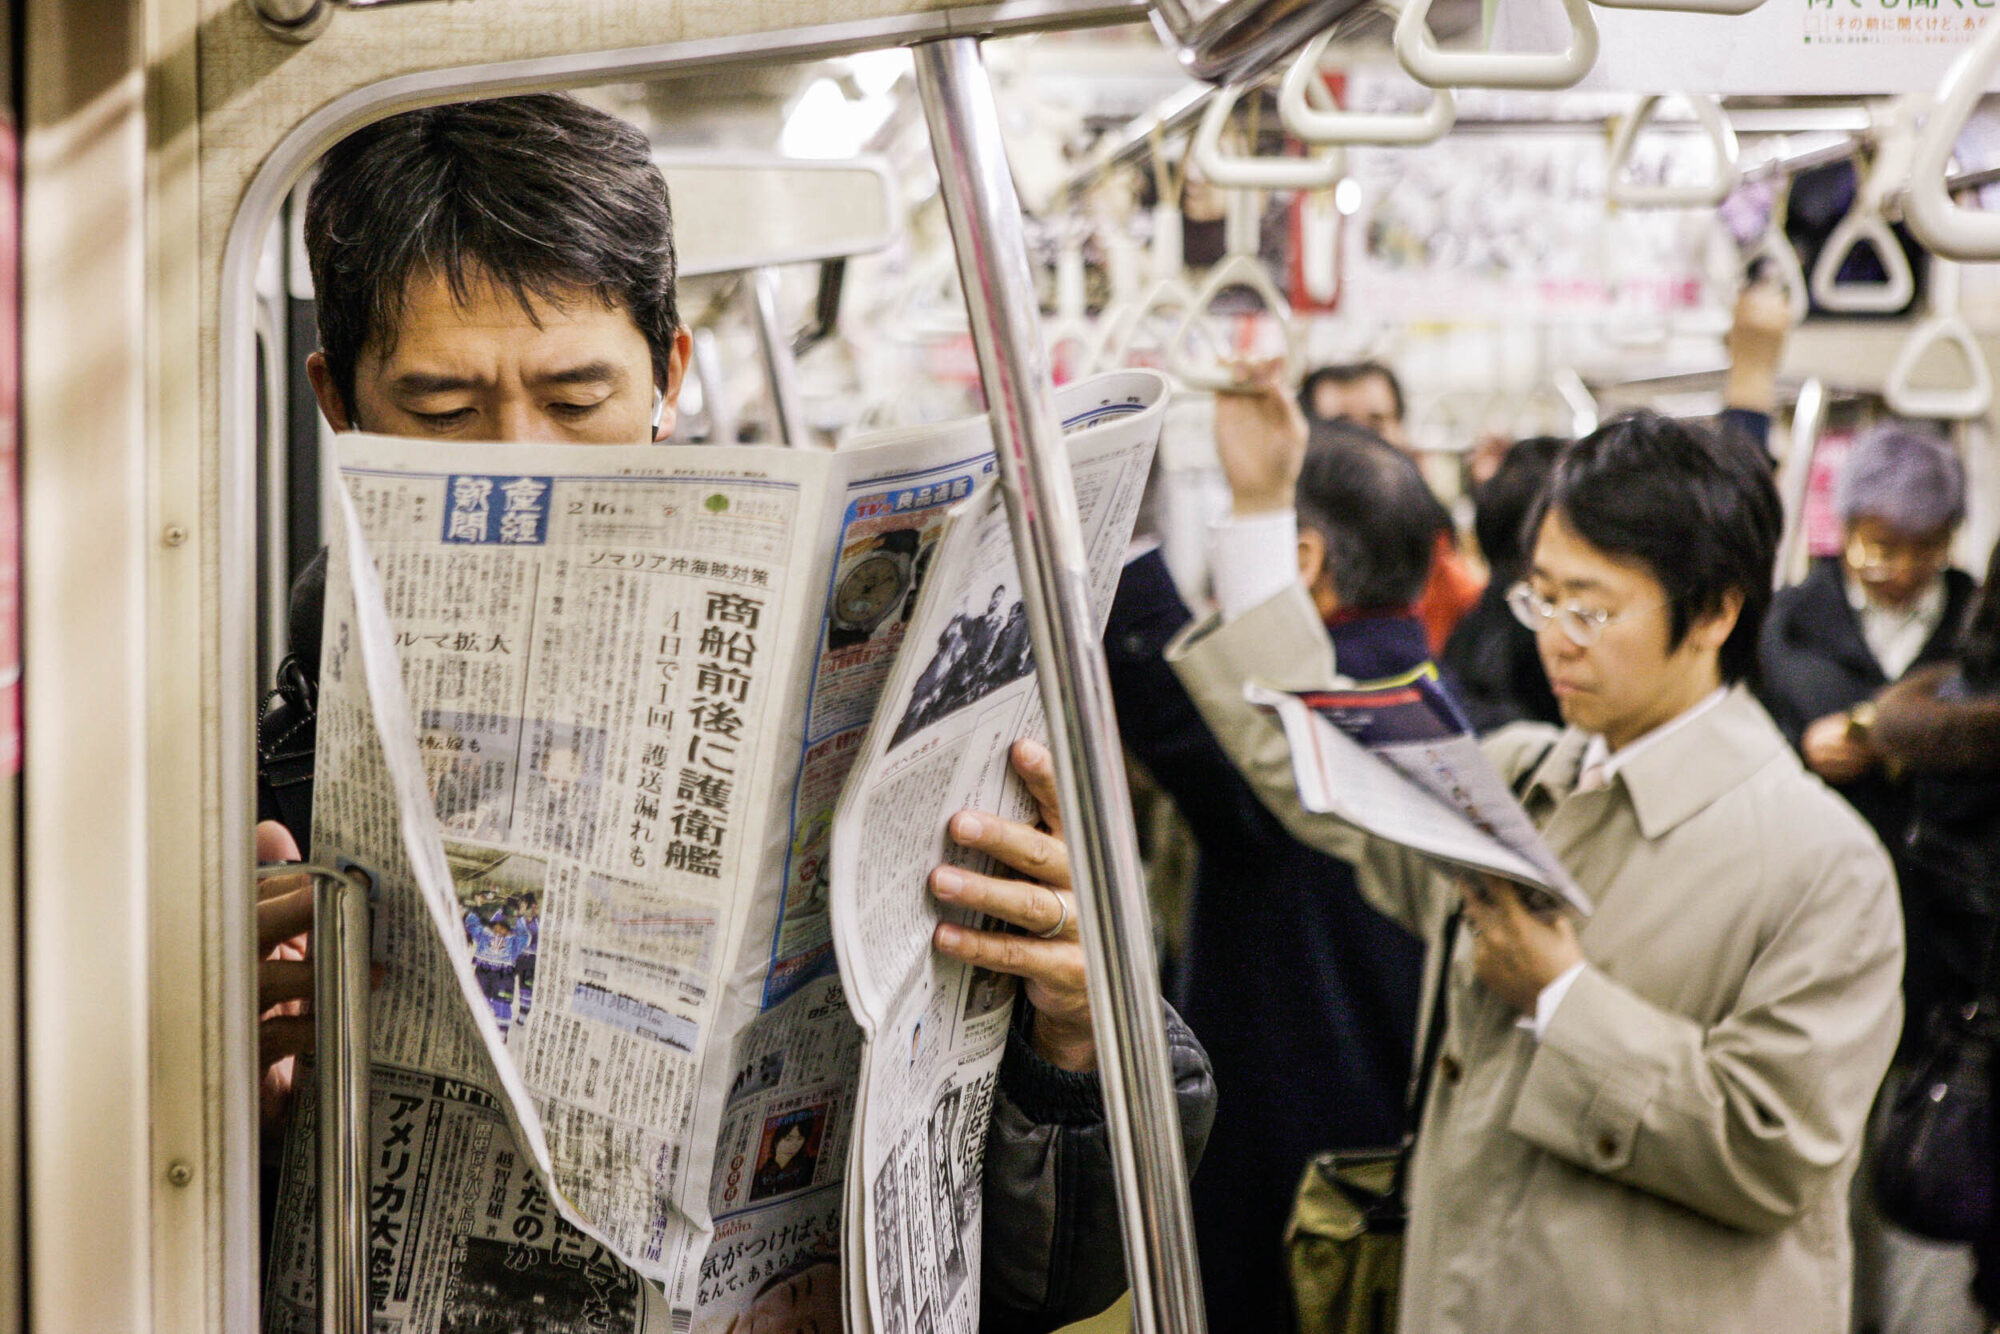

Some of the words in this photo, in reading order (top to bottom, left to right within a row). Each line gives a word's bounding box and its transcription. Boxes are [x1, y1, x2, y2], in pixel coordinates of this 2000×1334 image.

[589, 552, 770, 587] ソマリア沖海賊対策
[664, 590, 765, 880] 商船前後に護衛艦
